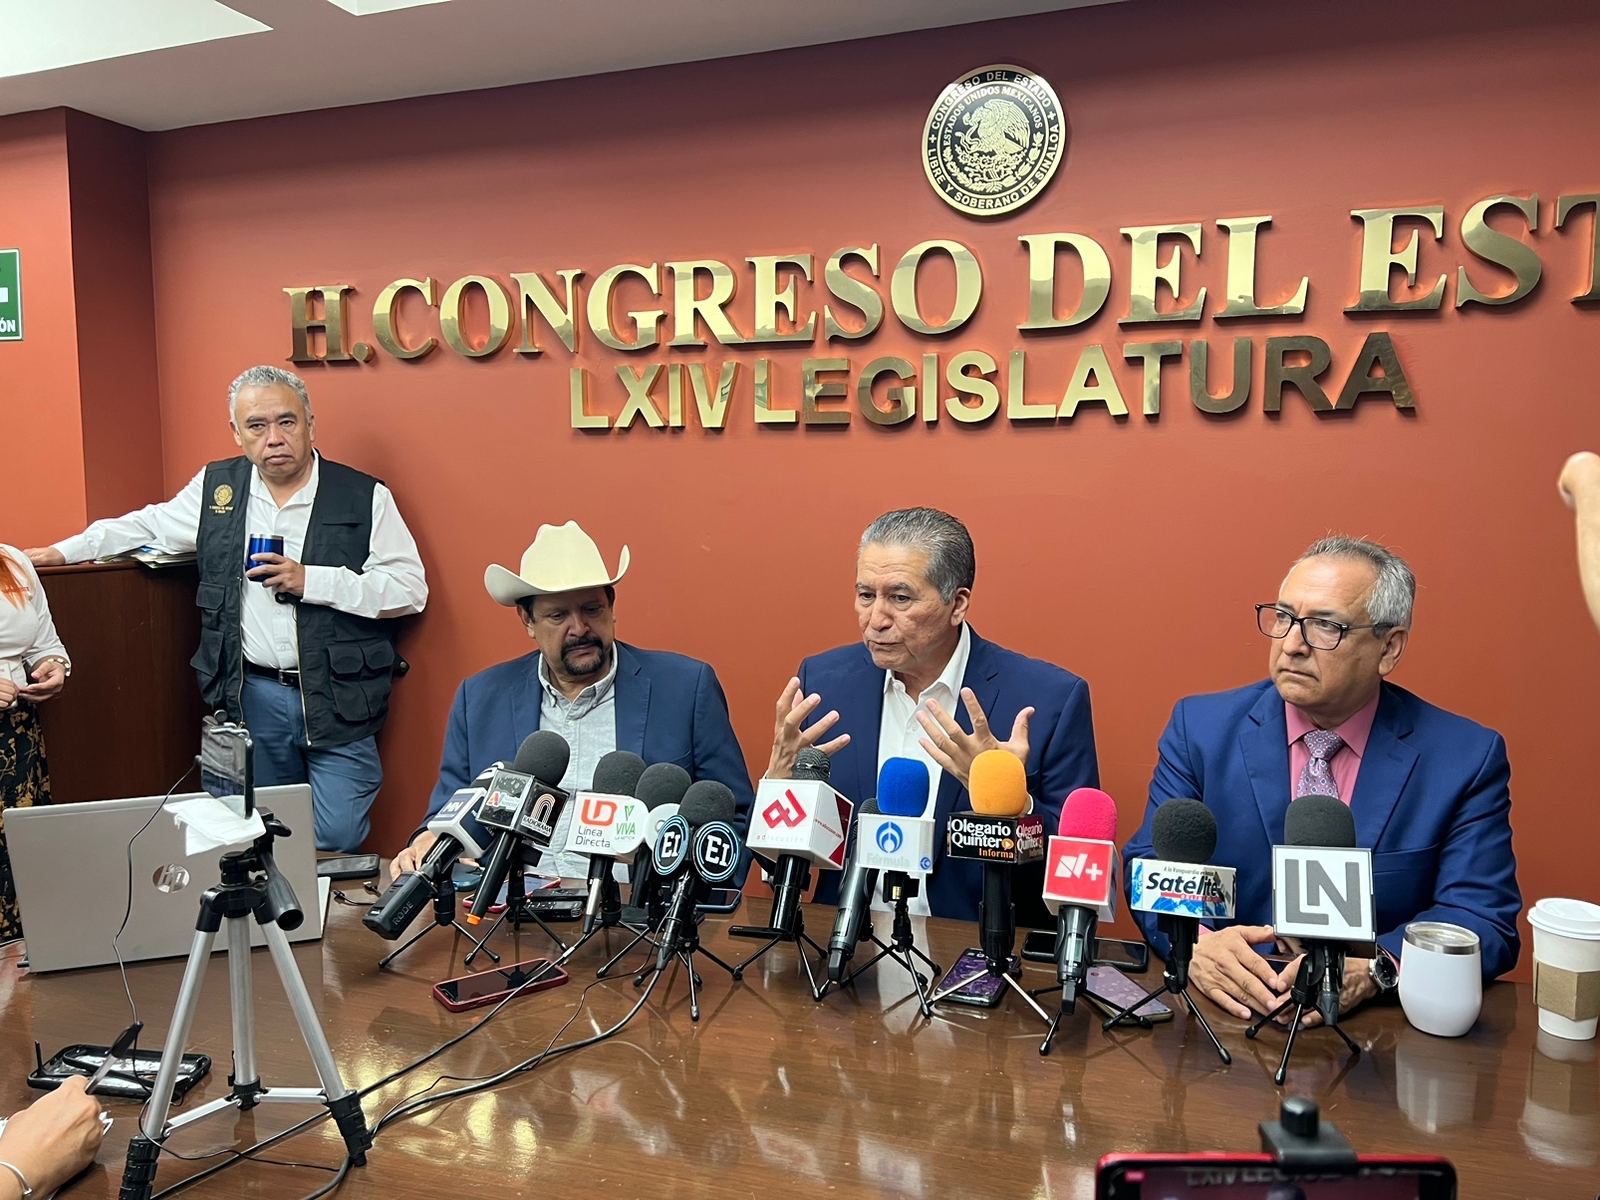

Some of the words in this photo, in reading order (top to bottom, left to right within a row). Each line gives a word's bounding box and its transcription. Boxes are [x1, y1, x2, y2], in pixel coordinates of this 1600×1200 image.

[932, 76, 981, 130] CONGRESO
[986, 71, 1009, 81] DEL
[1013, 74, 1052, 108] ESTADO
[943, 103, 967, 147] ESTADOS
[964, 85, 1001, 106] UNIDOS
[1001, 86, 1043, 129] MEXICANOS
[928, 149, 947, 185] LIBRE
[944, 183, 955, 193] Y
[954, 192, 1020, 209] SOBERANO
[1020, 179, 1038, 197] DE
[1035, 123, 1061, 181] SINALOA
[1017, 215, 1309, 331] DEL
[569, 361, 738, 430] LXIV
[754, 332, 1415, 426] LEGISLATURA
[578, 825, 603, 838] Línea
[616, 822, 636, 835] VIVA
[951, 818, 1012, 837] Olegario
[575, 835, 611, 848] Directa
[978, 847, 1014, 859] Informa
[866, 852, 911, 868] Fórmula
[1146, 871, 1219, 897] Satélite
[1285, 858, 1362, 928] LN
